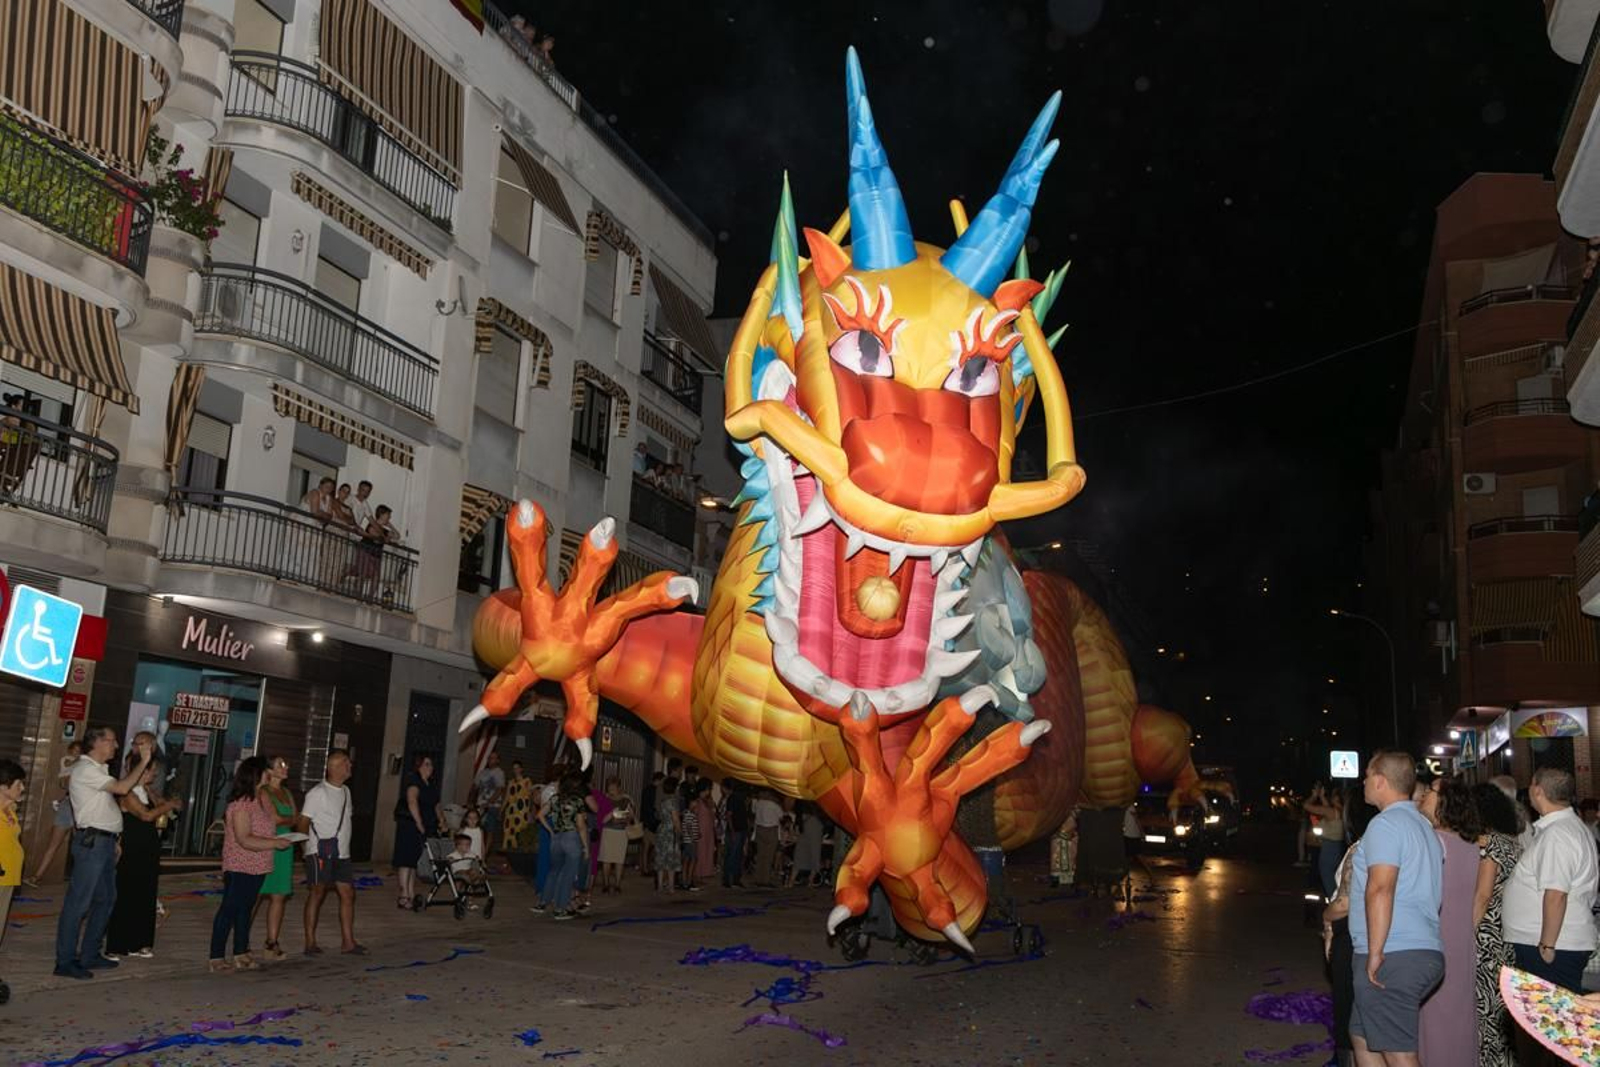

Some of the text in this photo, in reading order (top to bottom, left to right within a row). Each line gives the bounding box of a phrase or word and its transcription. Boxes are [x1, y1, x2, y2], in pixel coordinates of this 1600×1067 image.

[181, 616, 255, 660] Mulier
[176, 692, 230, 712] SE TRASPASA
[173, 709, 228, 728] 667 213 927
